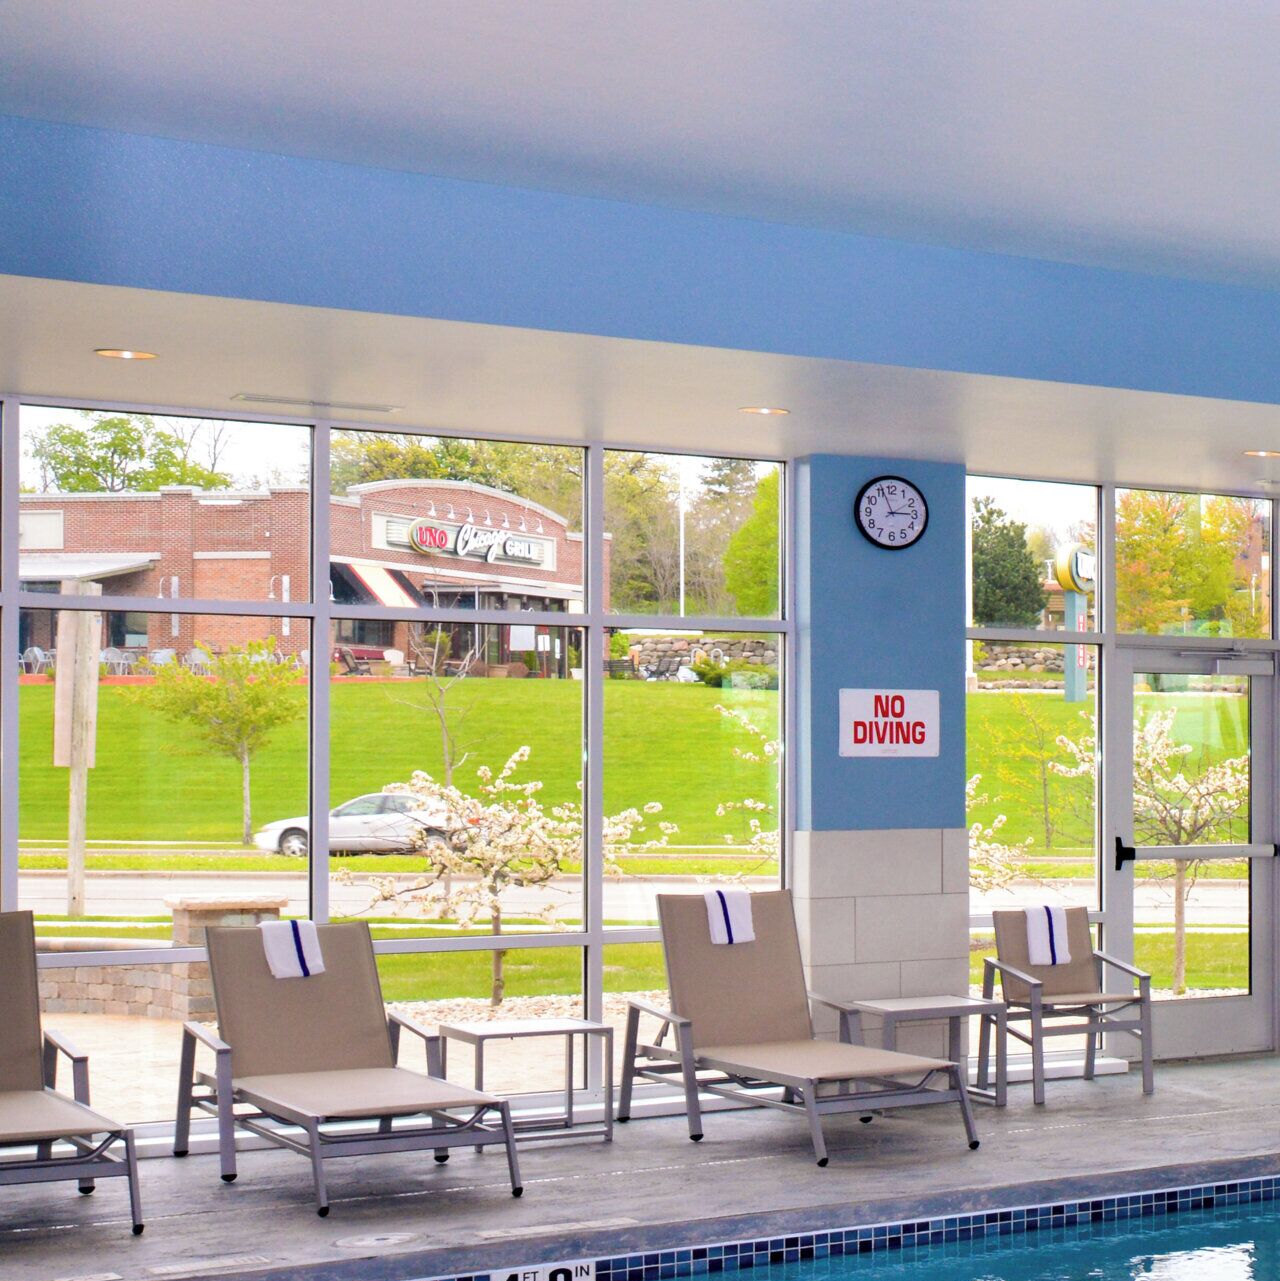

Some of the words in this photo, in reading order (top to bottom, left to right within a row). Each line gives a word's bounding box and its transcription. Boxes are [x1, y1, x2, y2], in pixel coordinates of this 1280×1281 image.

[876, 487, 884, 497] 11
[887, 485, 897, 495] 12
[901, 490, 905, 499] 1
[866, 495, 877, 505] 10
[908, 498, 915, 507] 2
[865, 507, 872, 517] 9
[911, 510, 918, 519] 3
[868, 519, 875, 528] 8
[908, 521, 914, 530] 4
[877, 528, 884, 537] 7
[888, 531, 895, 541] 6
[900, 529, 907, 539] 5
[417, 526, 448, 549] UNO
[456, 523, 513, 563] Chicago
[874, 695, 905, 718] NO
[853, 721, 926, 744] DIVING
